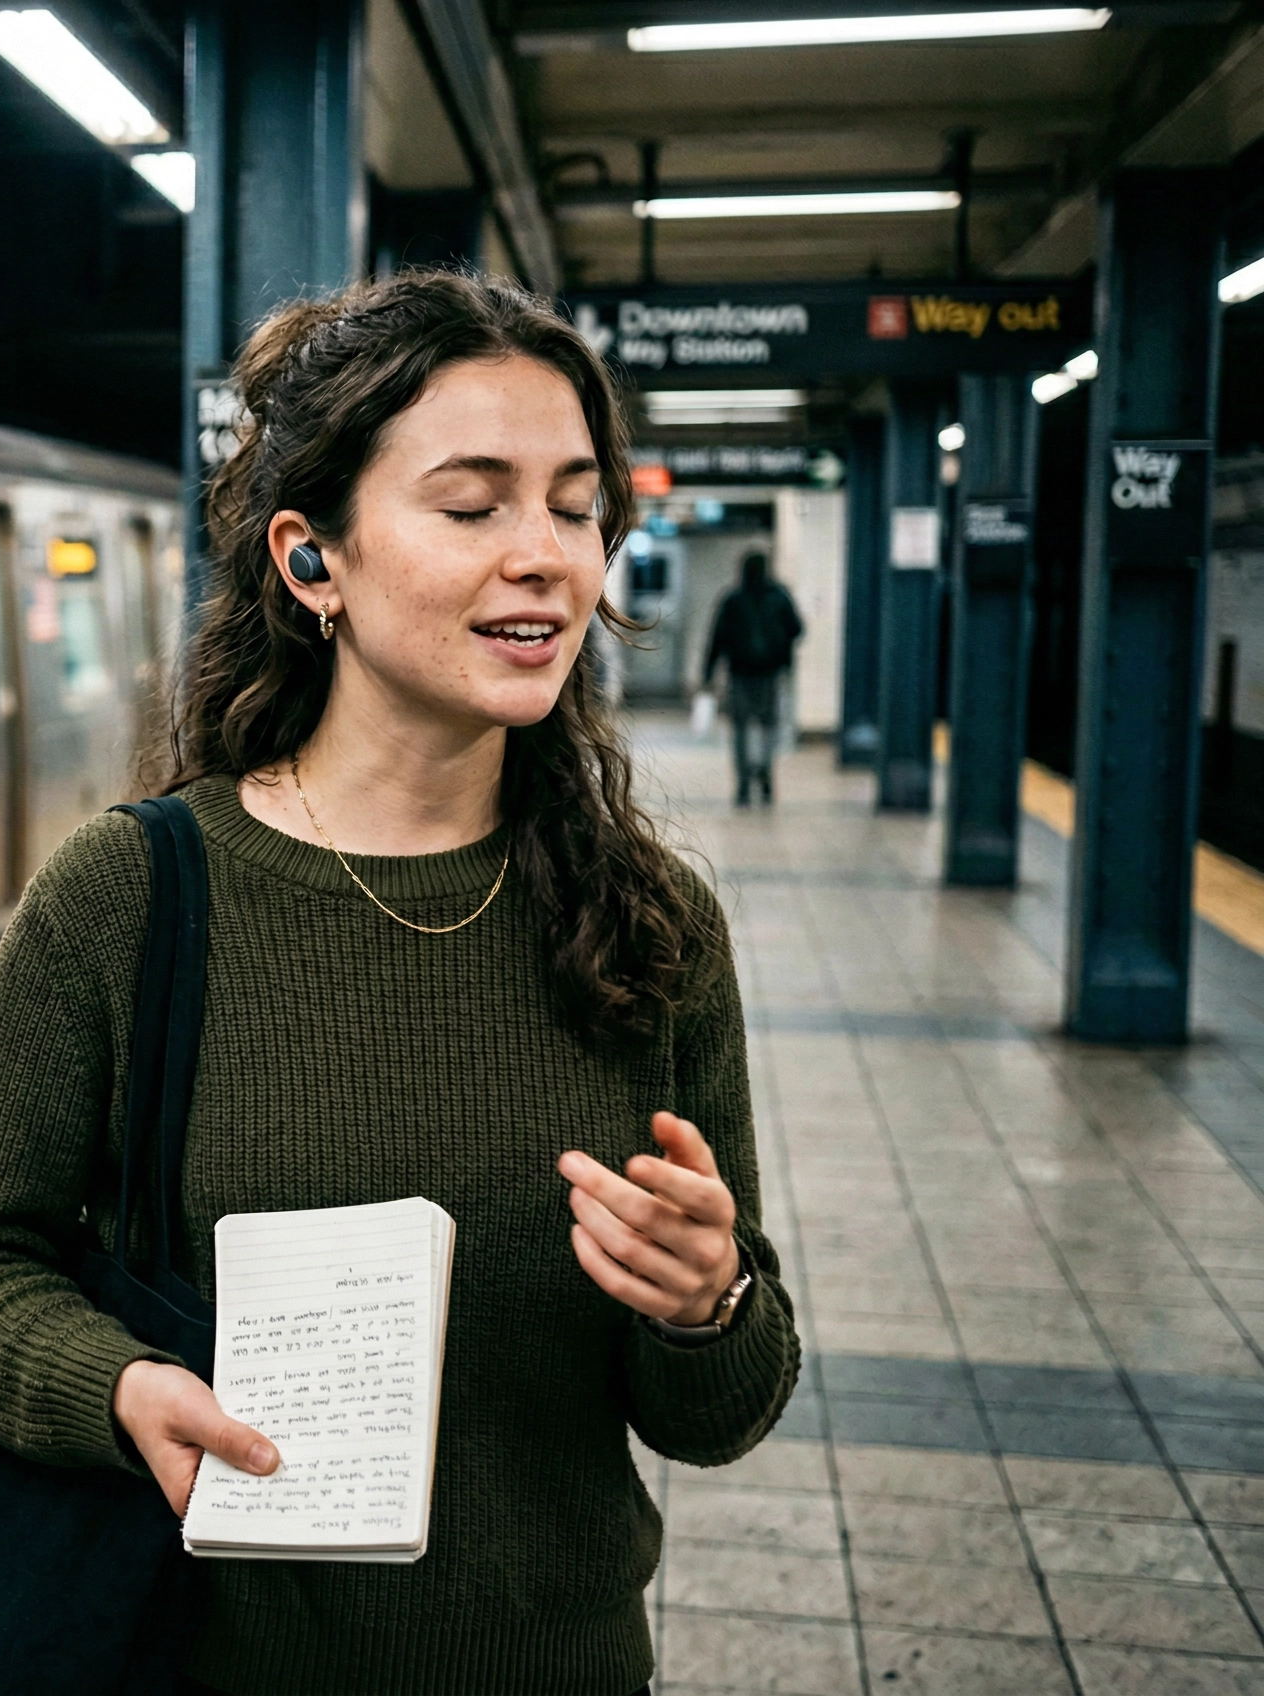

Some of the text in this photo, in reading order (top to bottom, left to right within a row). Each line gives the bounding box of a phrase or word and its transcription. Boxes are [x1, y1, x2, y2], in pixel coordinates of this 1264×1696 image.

[618, 300, 809, 336] Downtown
[911, 295, 990, 339] Way
[998, 296, 1059, 332] out
[1113, 446, 1181, 483] Way
[1111, 477, 1171, 509] Out
